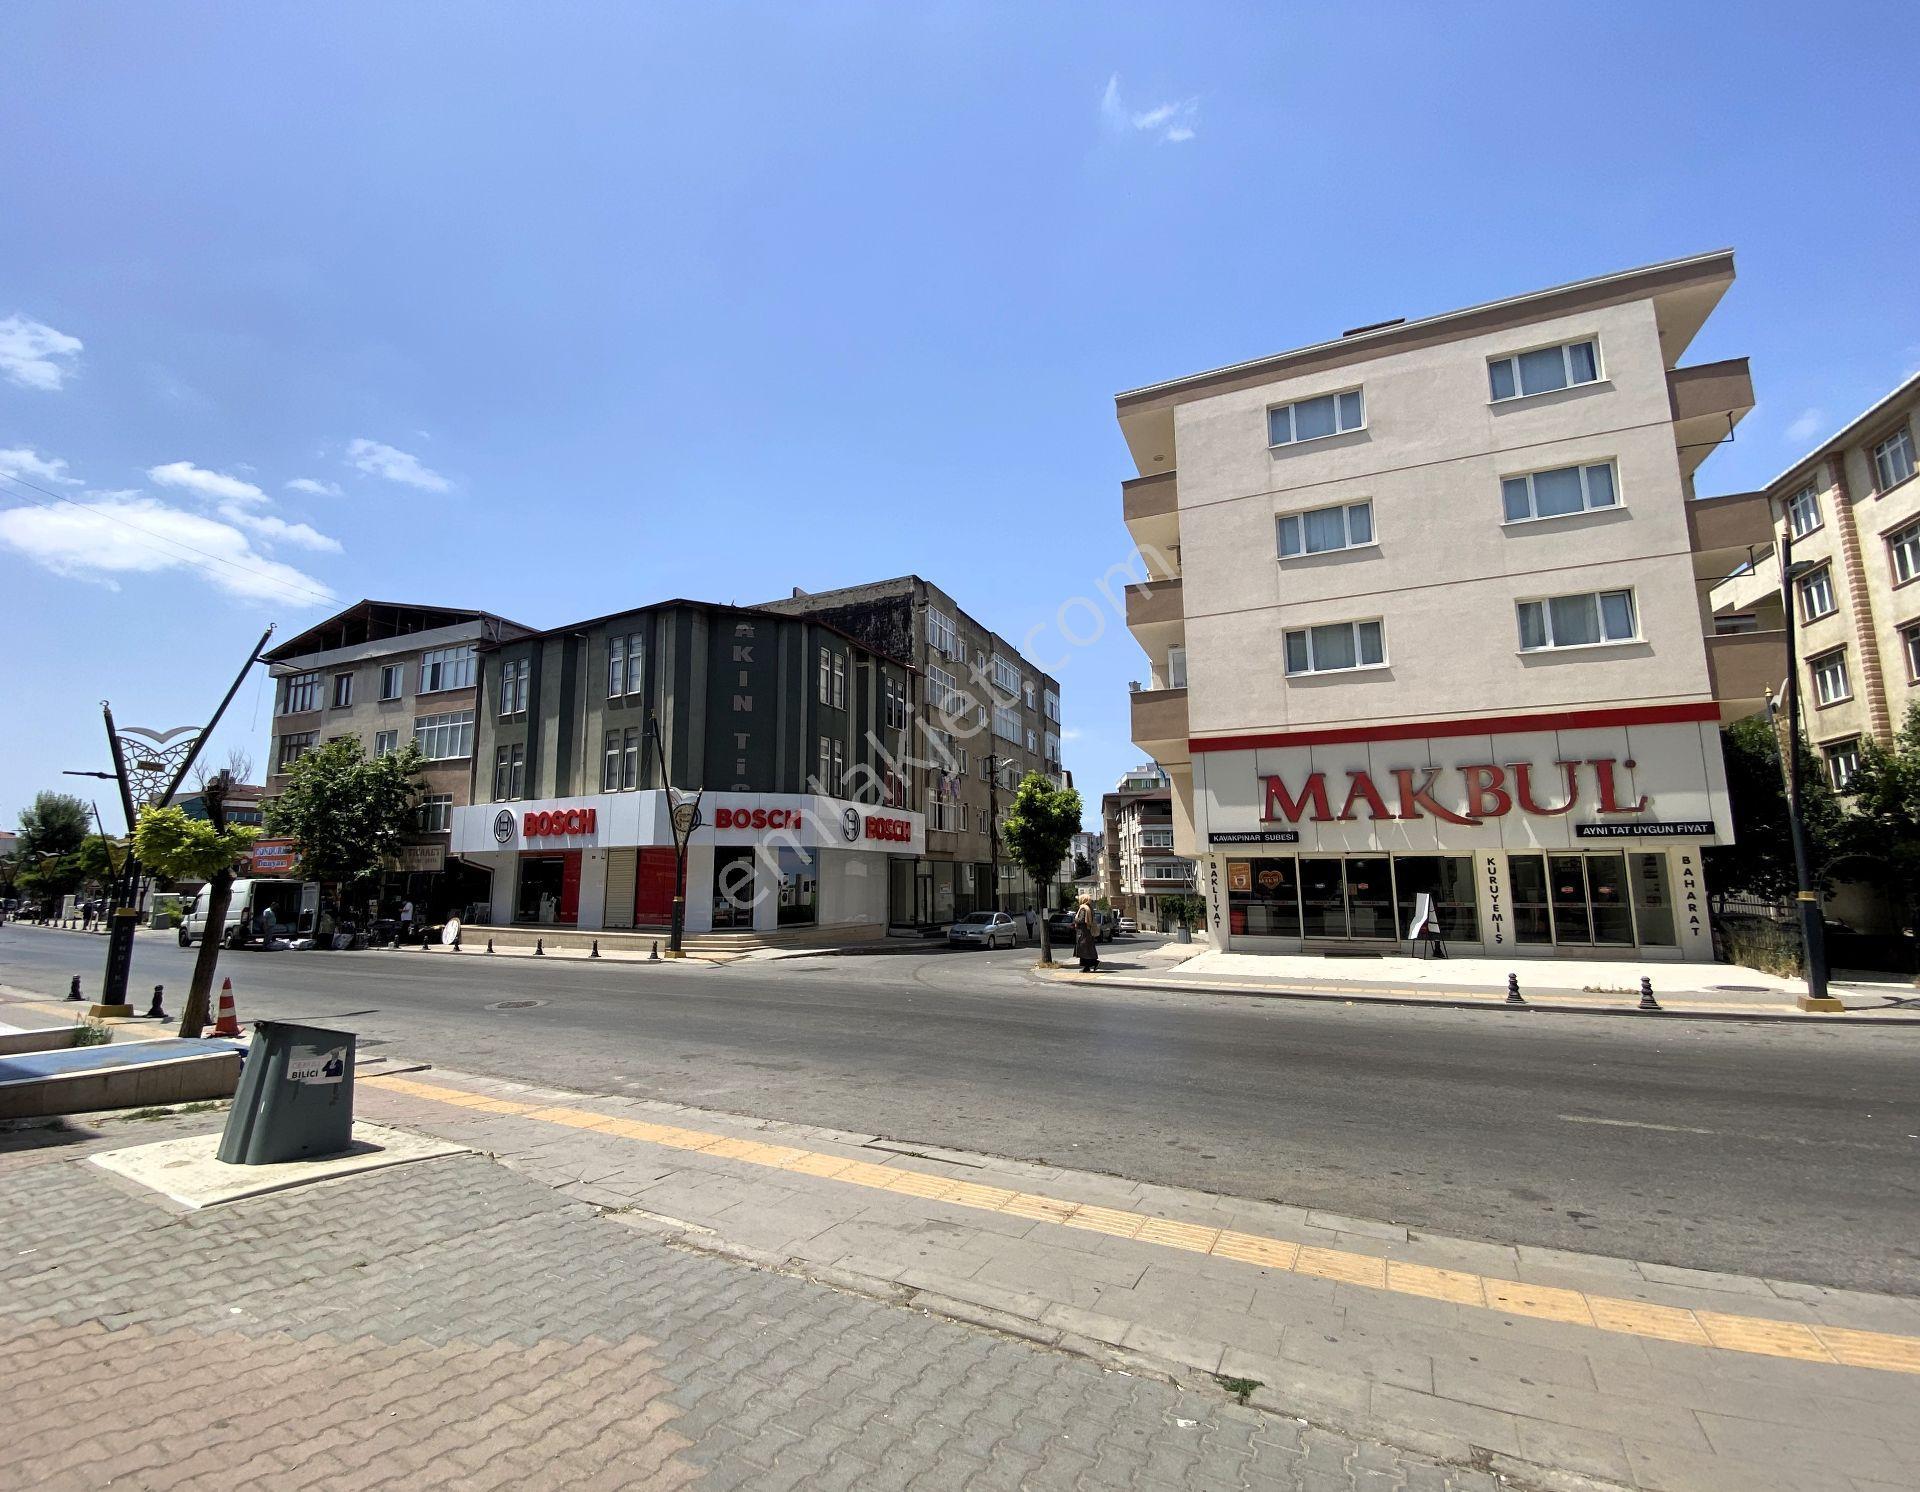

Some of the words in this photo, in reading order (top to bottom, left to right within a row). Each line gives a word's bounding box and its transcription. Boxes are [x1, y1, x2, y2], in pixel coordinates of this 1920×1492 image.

[732, 623, 756, 712] AKIN
[1258, 758, 1649, 826] MAKBUL
[523, 808, 597, 837] BOSCH
[715, 808, 803, 830] BOSCH
[865, 815, 912, 843] BOSCH
[1583, 827, 1608, 835] AYNI
[1610, 826, 1631, 834] TAT
[1634, 824, 1674, 834] UYGUN
[1682, 856, 1700, 936] BAHARAT
